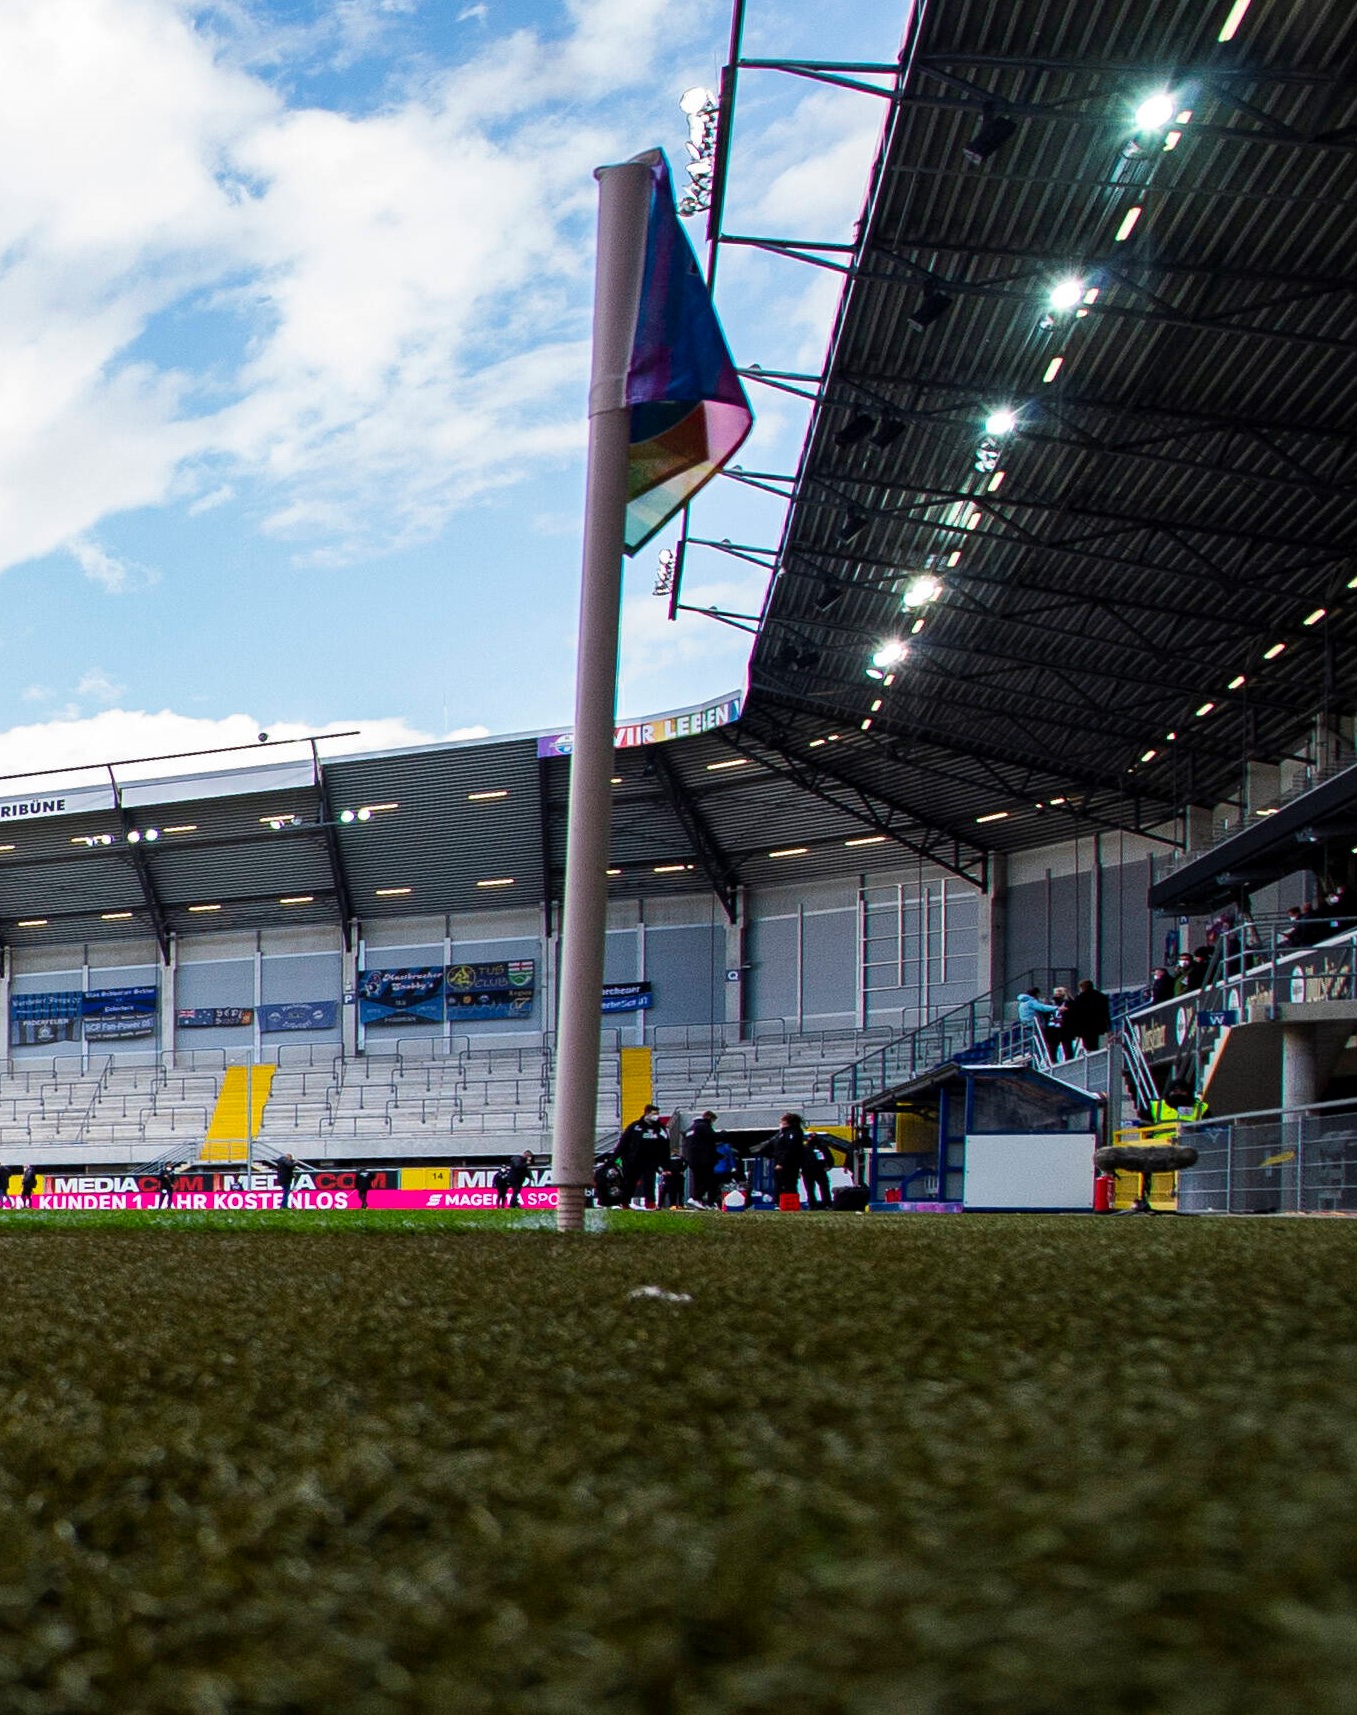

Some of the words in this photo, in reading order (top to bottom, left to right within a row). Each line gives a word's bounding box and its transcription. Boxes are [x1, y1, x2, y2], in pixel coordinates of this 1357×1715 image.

[727, 971, 739, 980] Q
[345, 995, 353, 1003] P
[433, 1172, 443, 1180] 14
[55, 1176, 204, 1193] MEDIACM
[39, 1195, 127, 1210] KUNDEN
[132, 1195, 143, 1210] 1
[213, 1192, 349, 1210] KOSTENLOS
